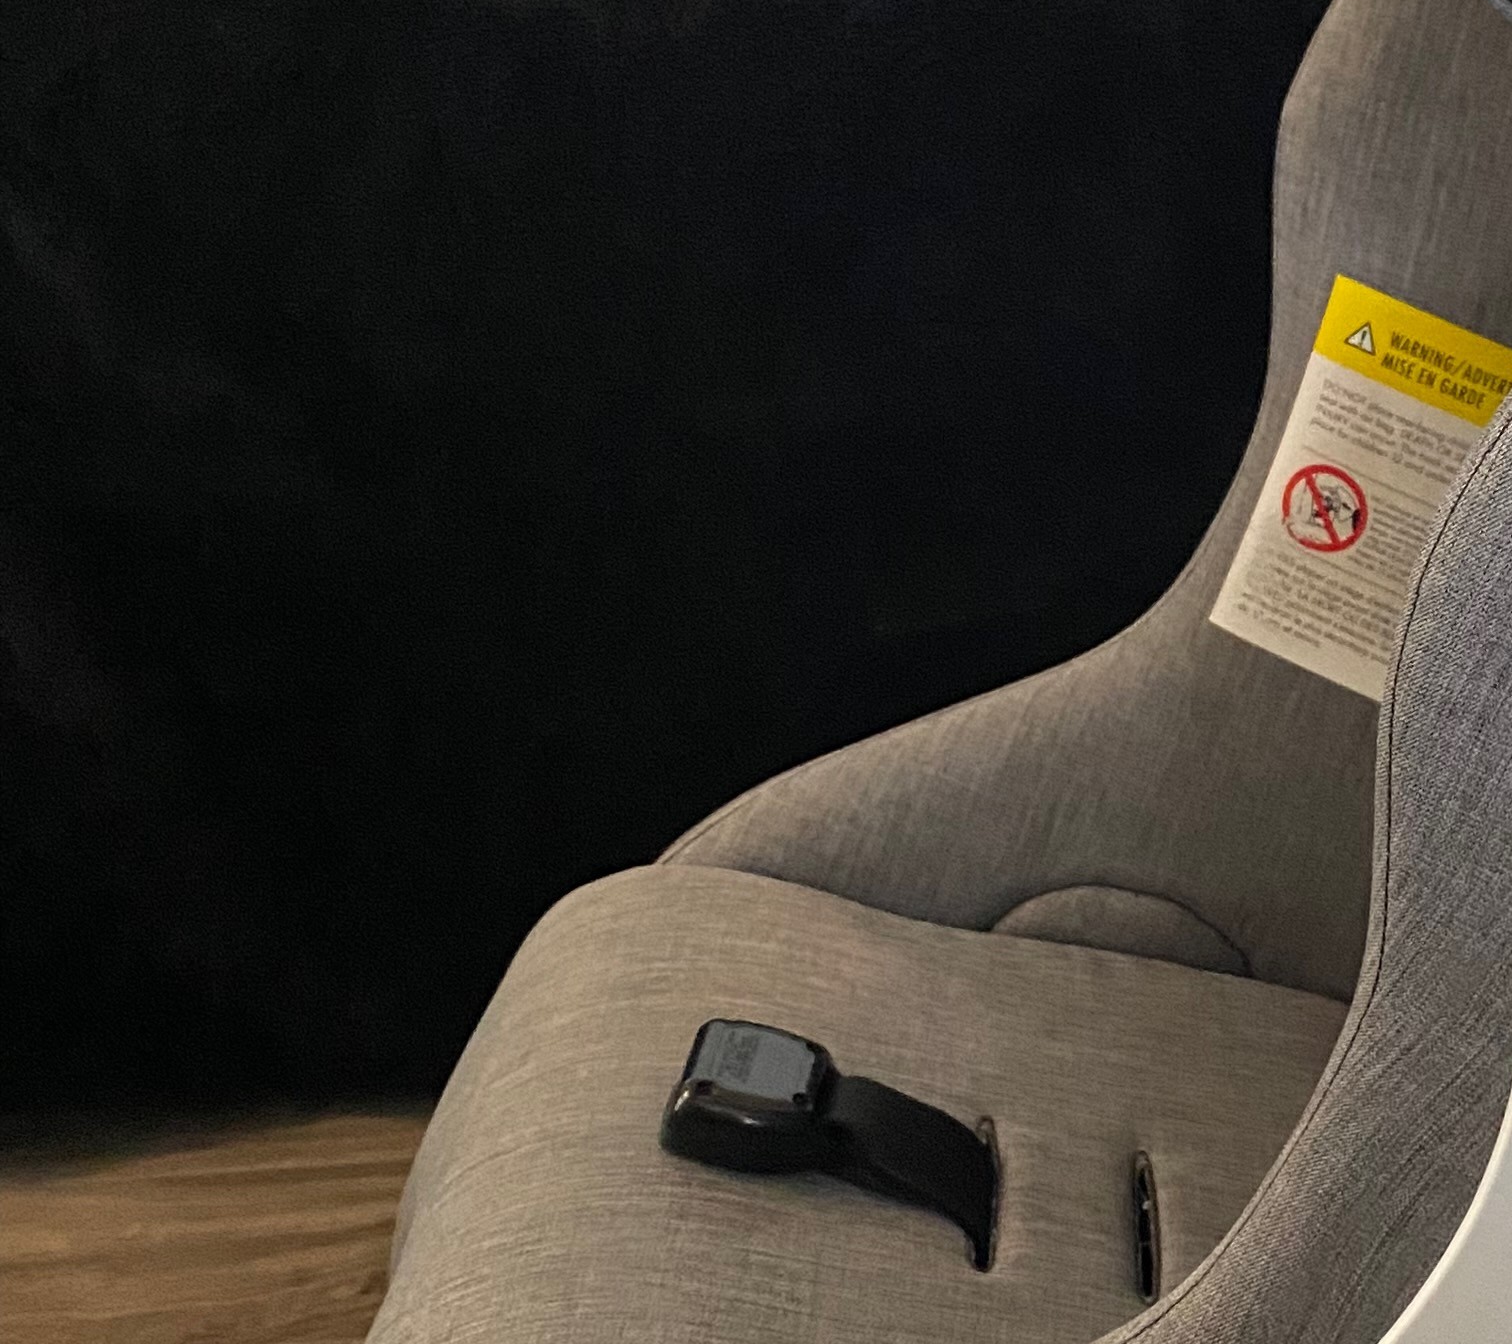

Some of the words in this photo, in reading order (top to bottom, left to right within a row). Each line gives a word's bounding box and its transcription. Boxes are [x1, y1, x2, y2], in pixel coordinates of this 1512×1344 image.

[1381, 353, 1416, 379] MISE
[1416, 368, 1437, 388] EN
[1440, 378, 1486, 409] GARDE
